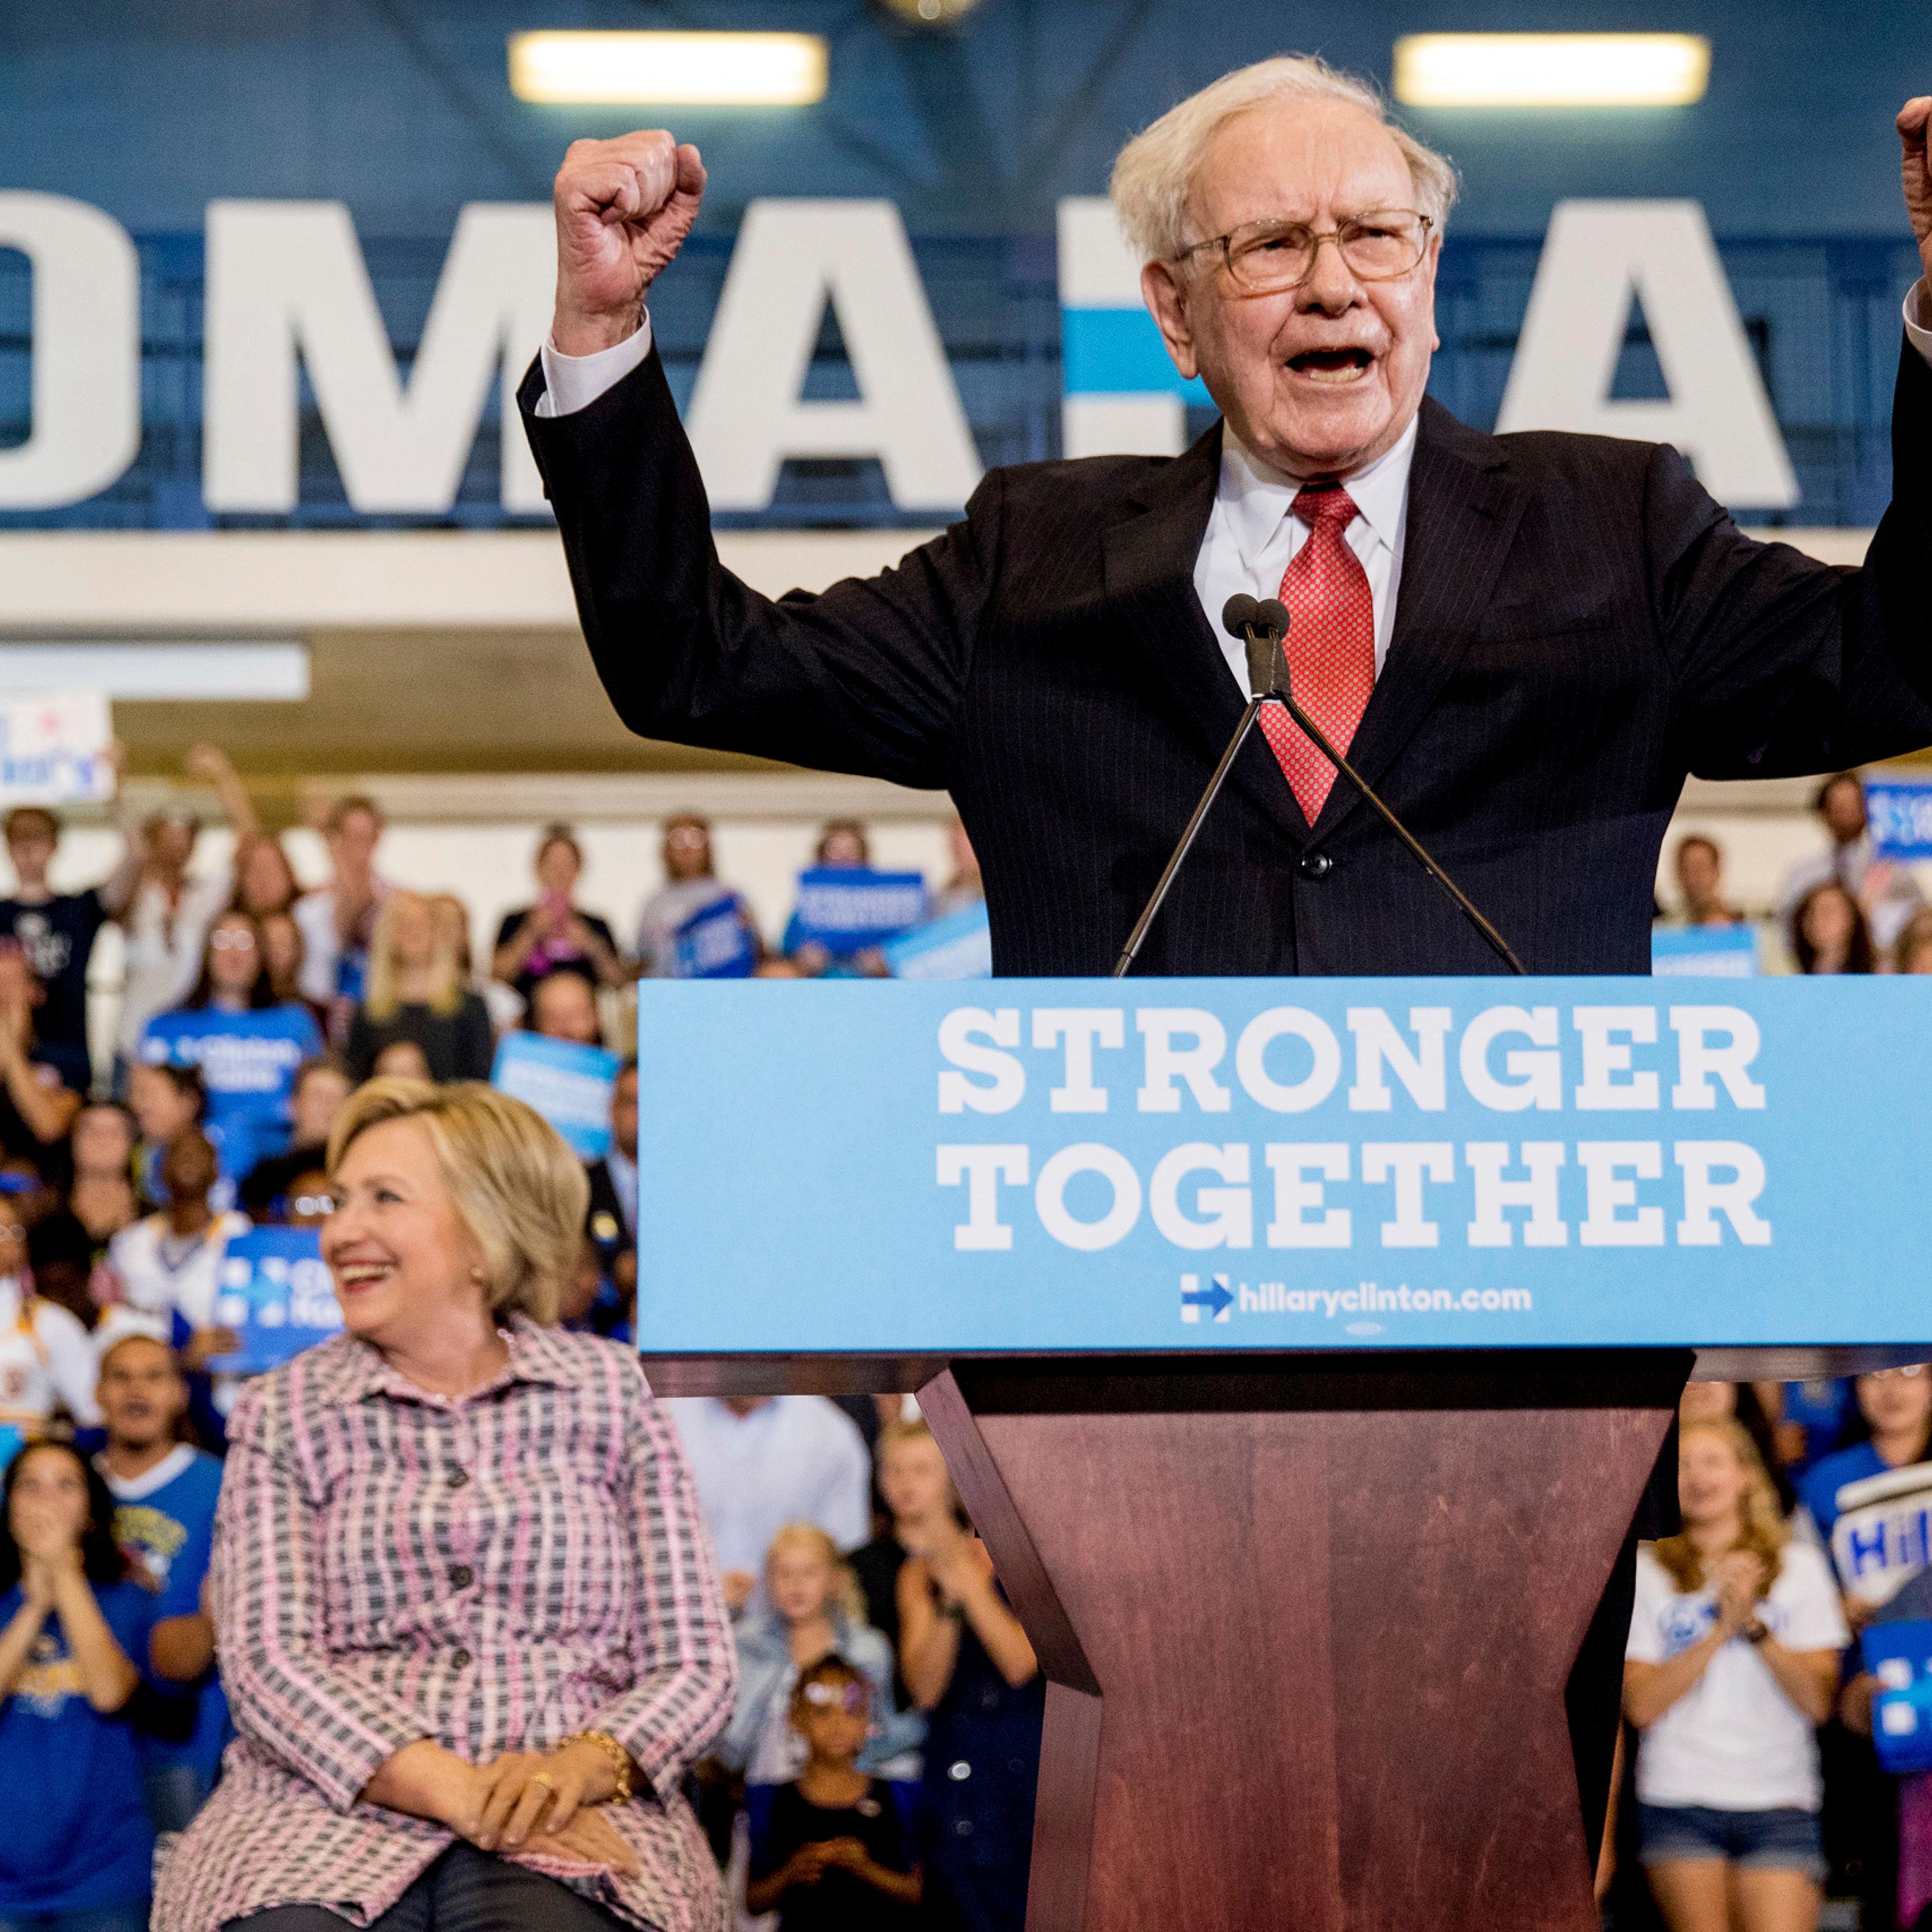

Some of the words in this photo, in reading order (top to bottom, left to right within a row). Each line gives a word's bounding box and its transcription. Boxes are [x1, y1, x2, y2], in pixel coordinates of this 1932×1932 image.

[936, 1005, 1767, 1115] STRONGER
[935, 1140, 1773, 1252] TOGETHER
[1238, 1281, 1533, 1318] hillaryclinton.com
